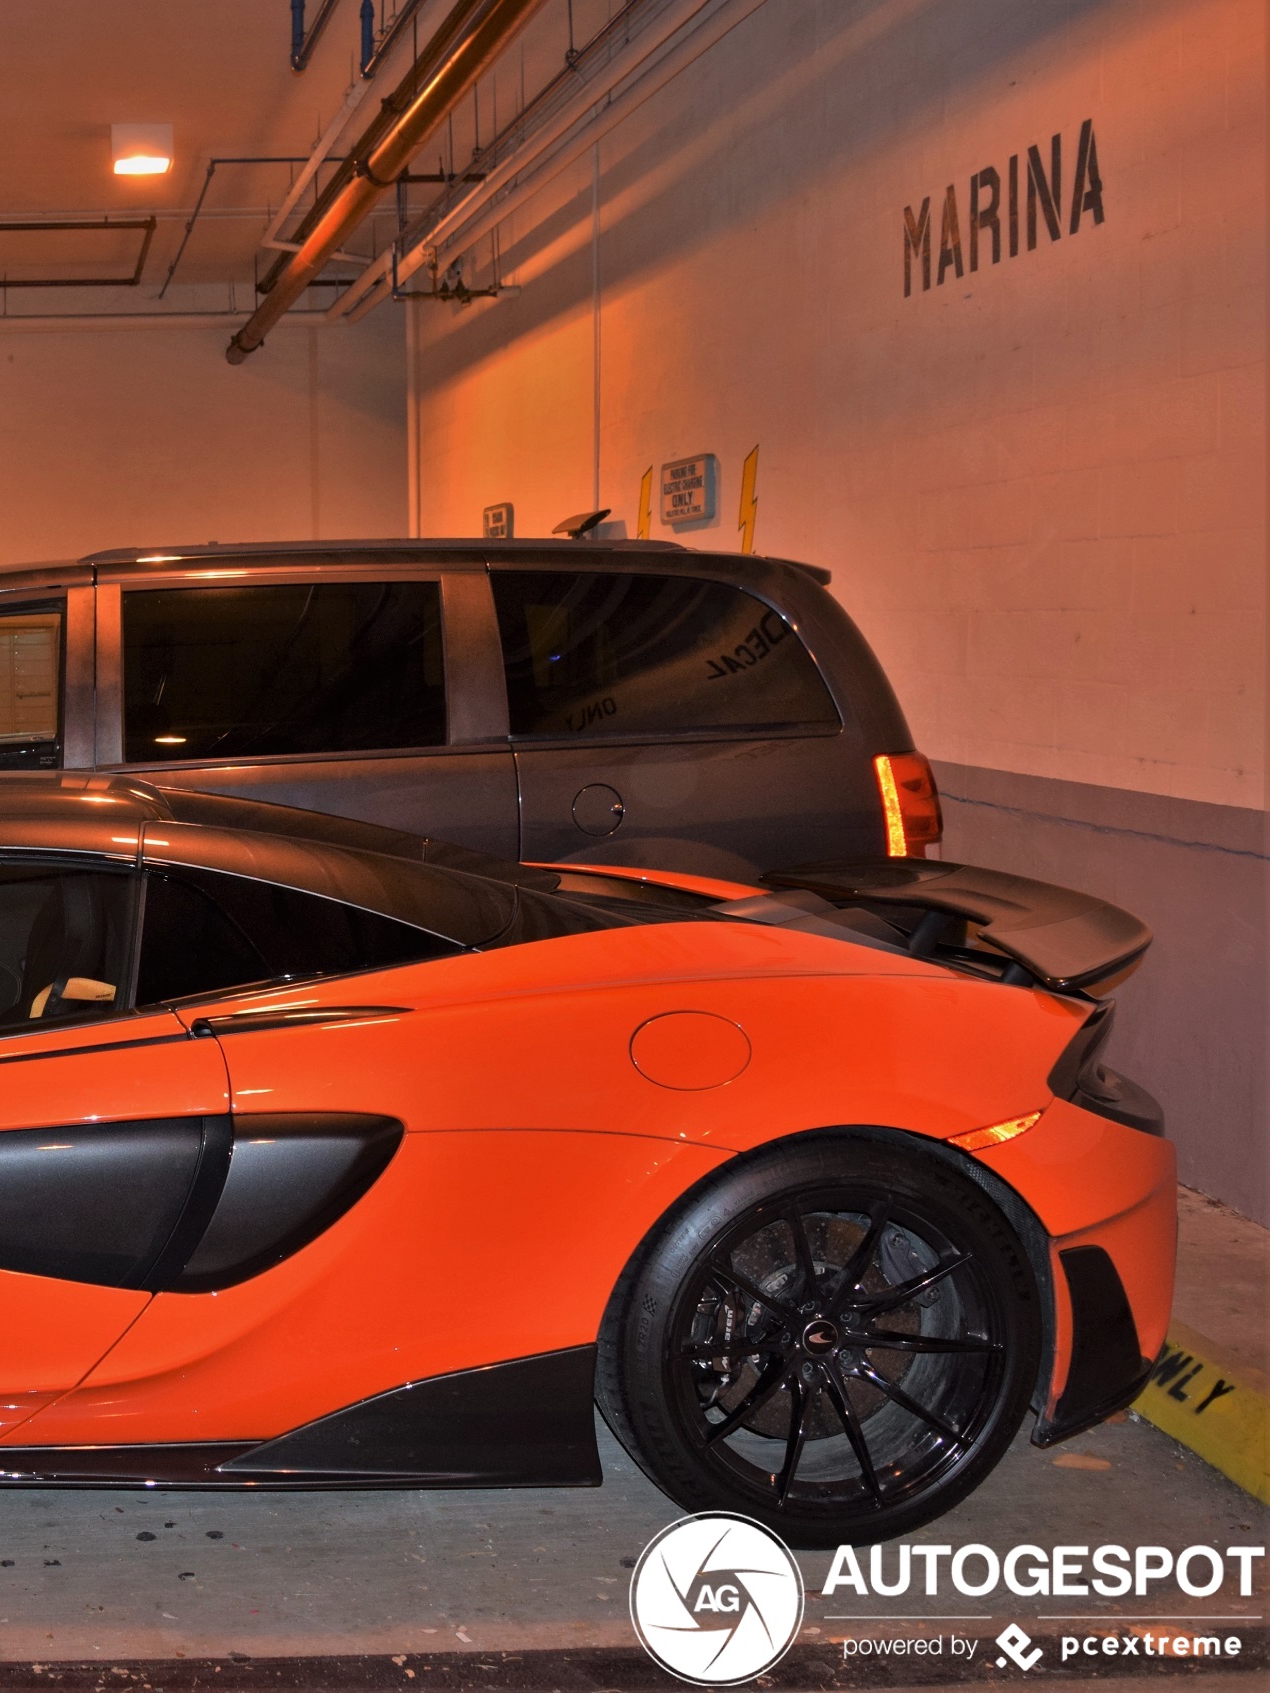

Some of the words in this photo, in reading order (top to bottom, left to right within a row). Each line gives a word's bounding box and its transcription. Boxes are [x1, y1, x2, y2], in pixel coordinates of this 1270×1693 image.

[903, 118, 1106, 298] MARINA
[673, 492, 692, 507] ONLY
[721, 1309, 734, 1370] Maren
[1151, 1344, 1236, 1415] NLY
